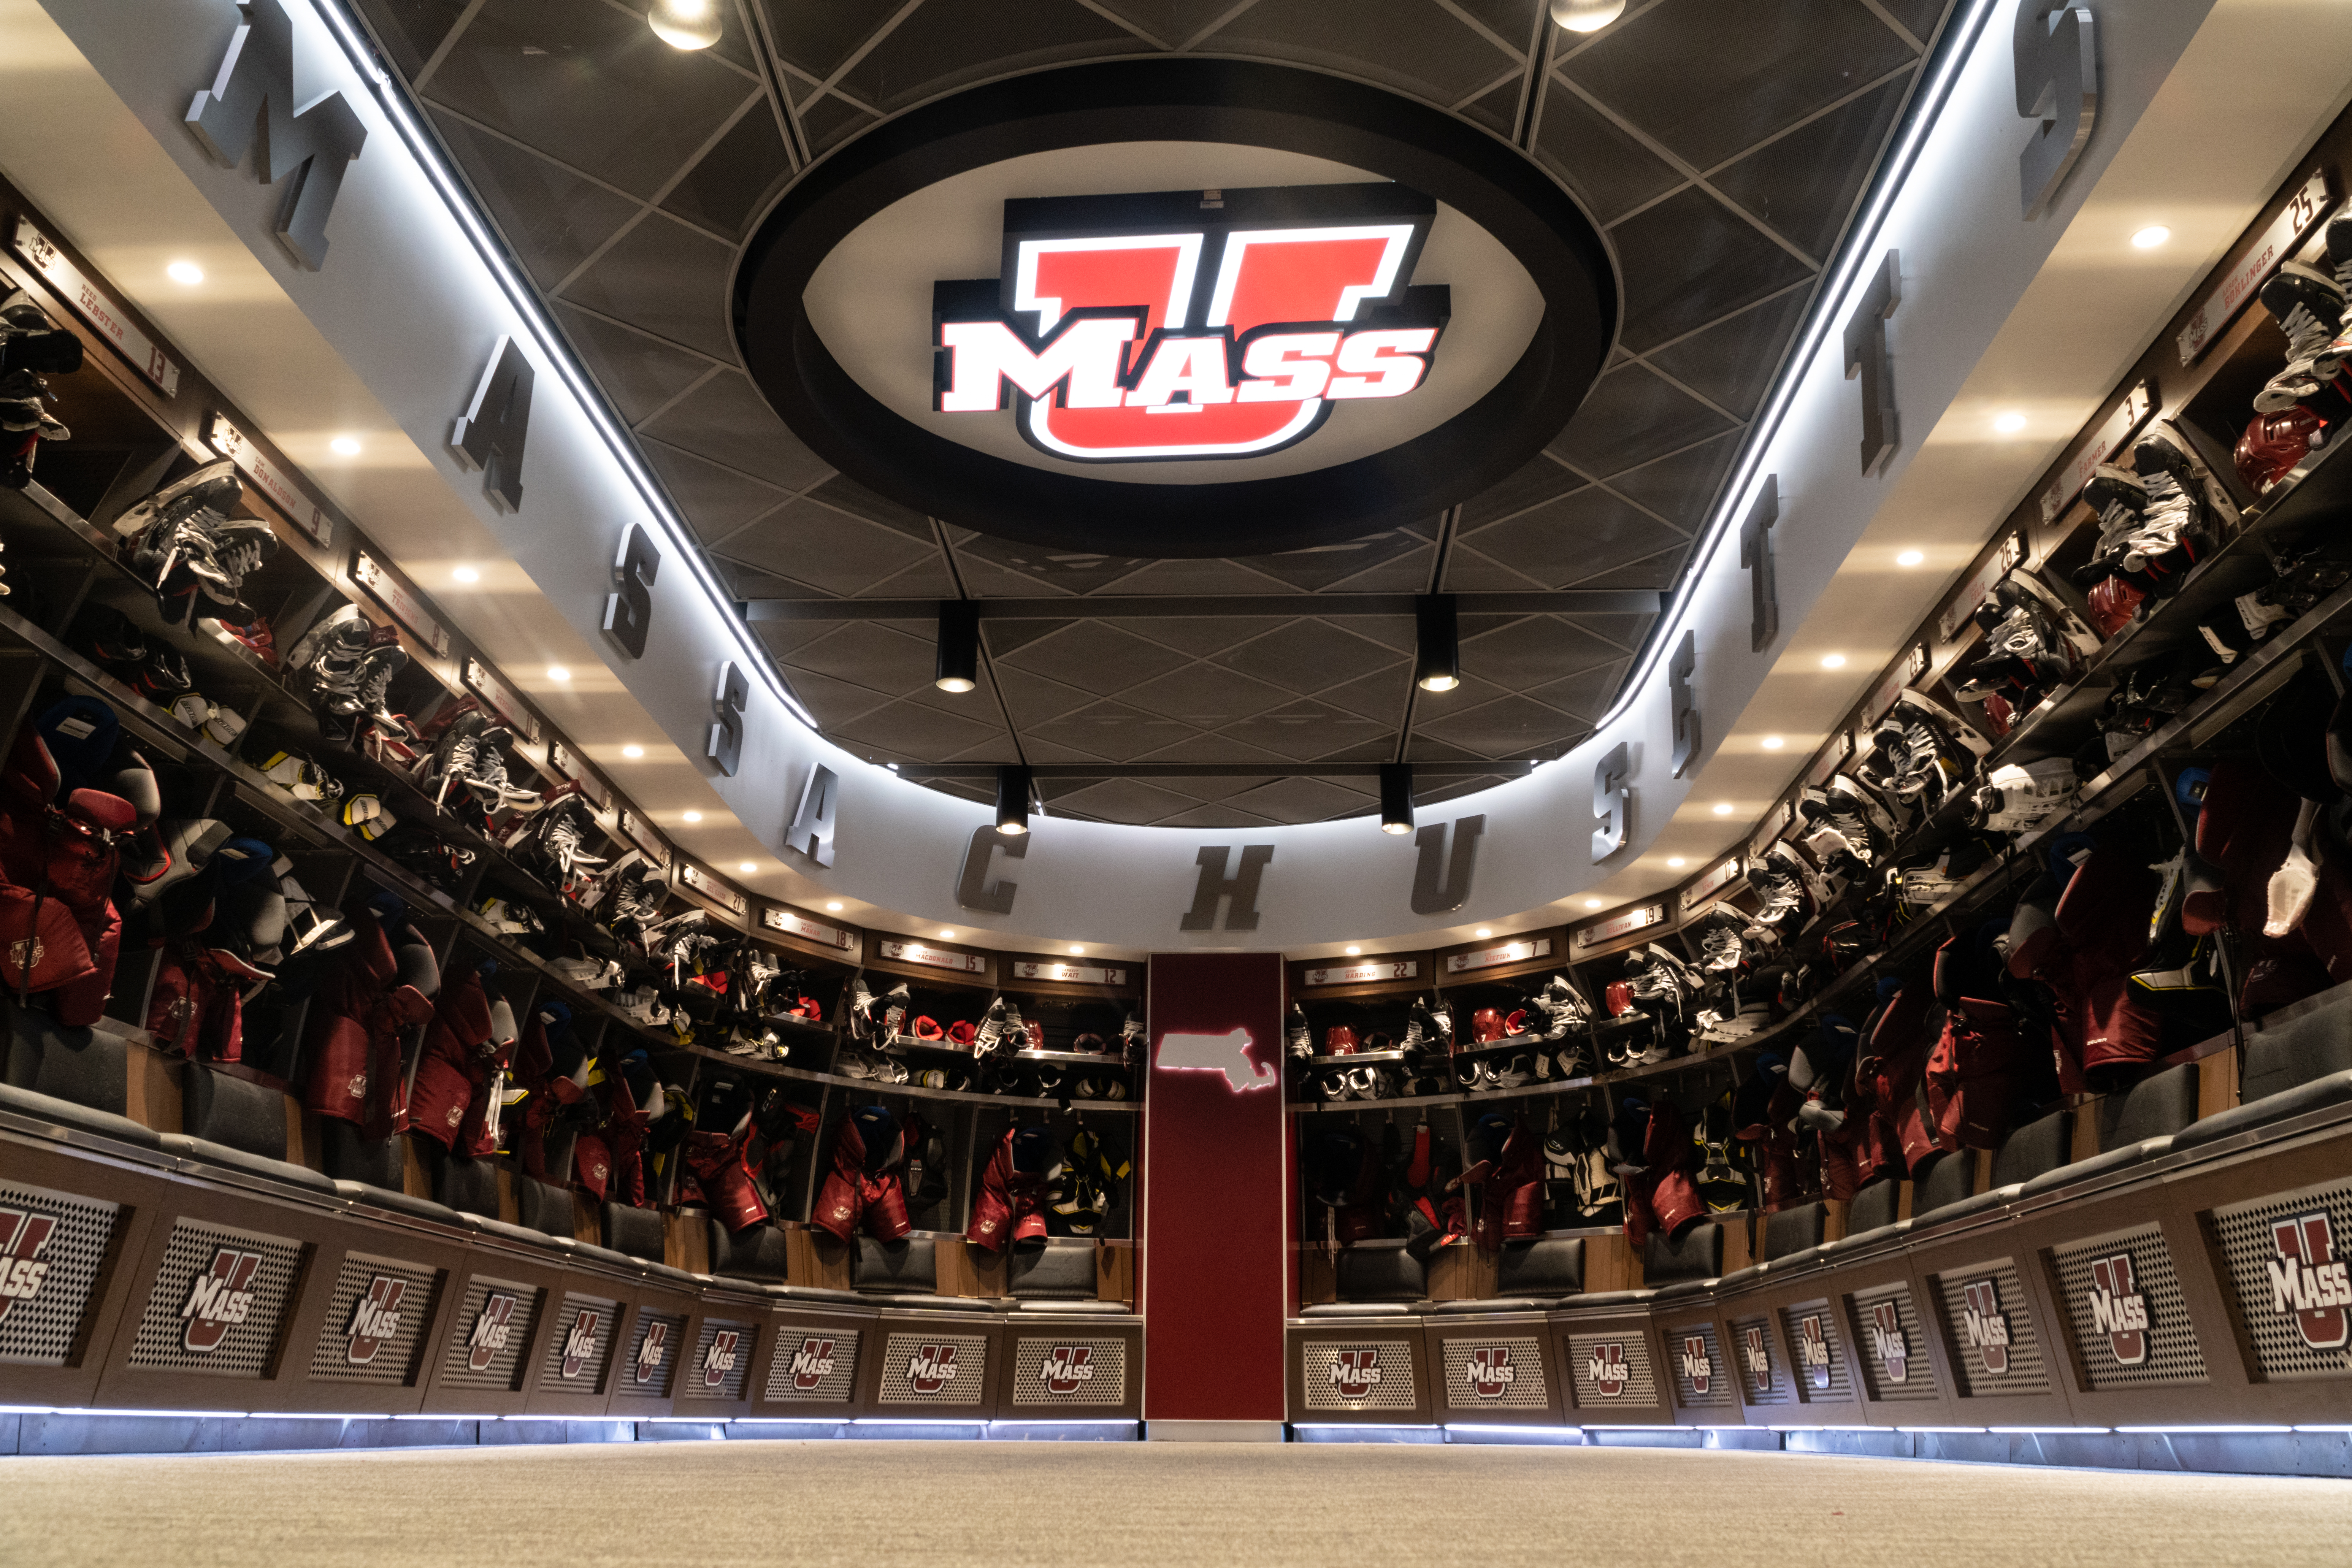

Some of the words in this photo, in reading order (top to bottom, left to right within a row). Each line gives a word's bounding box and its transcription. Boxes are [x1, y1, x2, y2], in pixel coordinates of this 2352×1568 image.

[2290, 185, 2314, 238] 25
[2222, 275, 2238, 298] AARON
[2224, 244, 2274, 311] BOHLINGER
[82, 284, 97, 301] REED
[79, 293, 124, 339] LEBSTER
[148, 347, 166, 384] 13
[941, 317, 1439, 412] MASS
[2125, 396, 2135, 428] 3
[255, 457, 265, 468] CAM
[2079, 440, 2106, 479] FARMER
[254, 464, 296, 509] DONALDSON
[311, 507, 321, 536] 9
[2000, 539, 2013, 574] 26
[1971, 580, 1985, 604] FELIX
[432, 623, 439, 647] 8
[1908, 650, 1918, 679] 23
[526, 713, 533, 736] 11
[2113, 748, 2133, 757] CC
[733, 893, 741, 910] 27
[1607, 921, 1632, 934] SULLIVAN
[1645, 907, 1654, 924] 19
[801, 926, 820, 936] MAKAR
[836, 930, 846, 947] 18
[915, 954, 953, 964] MACDONALD
[1485, 953, 1511, 962] KIEFIUK
[1531, 941, 1538, 956] 7
[965, 955, 976, 970] 15
[1394, 962, 1407, 978] 22
[1104, 969, 1116, 984] 12
[1481, 1034, 1486, 1042] 7
[2267, 1254, 2352, 1313] MASS
[182, 1275, 254, 1324] MASS
[2089, 1289, 2149, 1334] MASS
[349, 1299, 401, 1338] MASS
[1963, 1308, 2008, 1347] MASS
[470, 1314, 510, 1349] MASS
[564, 1329, 596, 1358] MASS
[1872, 1327, 1906, 1359] MASS
[638, 1338, 664, 1365] MASS
[704, 1346, 736, 1370] MASS
[1747, 1346, 1768, 1372] MASS
[1802, 1337, 1829, 1365] MASS
[789, 1352, 835, 1375] MASS
[907, 1358, 958, 1380] MASS
[1040, 1360, 1093, 1381] MASS
[1329, 1364, 1381, 1383] MASS
[1467, 1362, 1514, 1383] MASS
[1589, 1359, 1628, 1381] MASS
[1683, 1354, 1710, 1377] MASS
